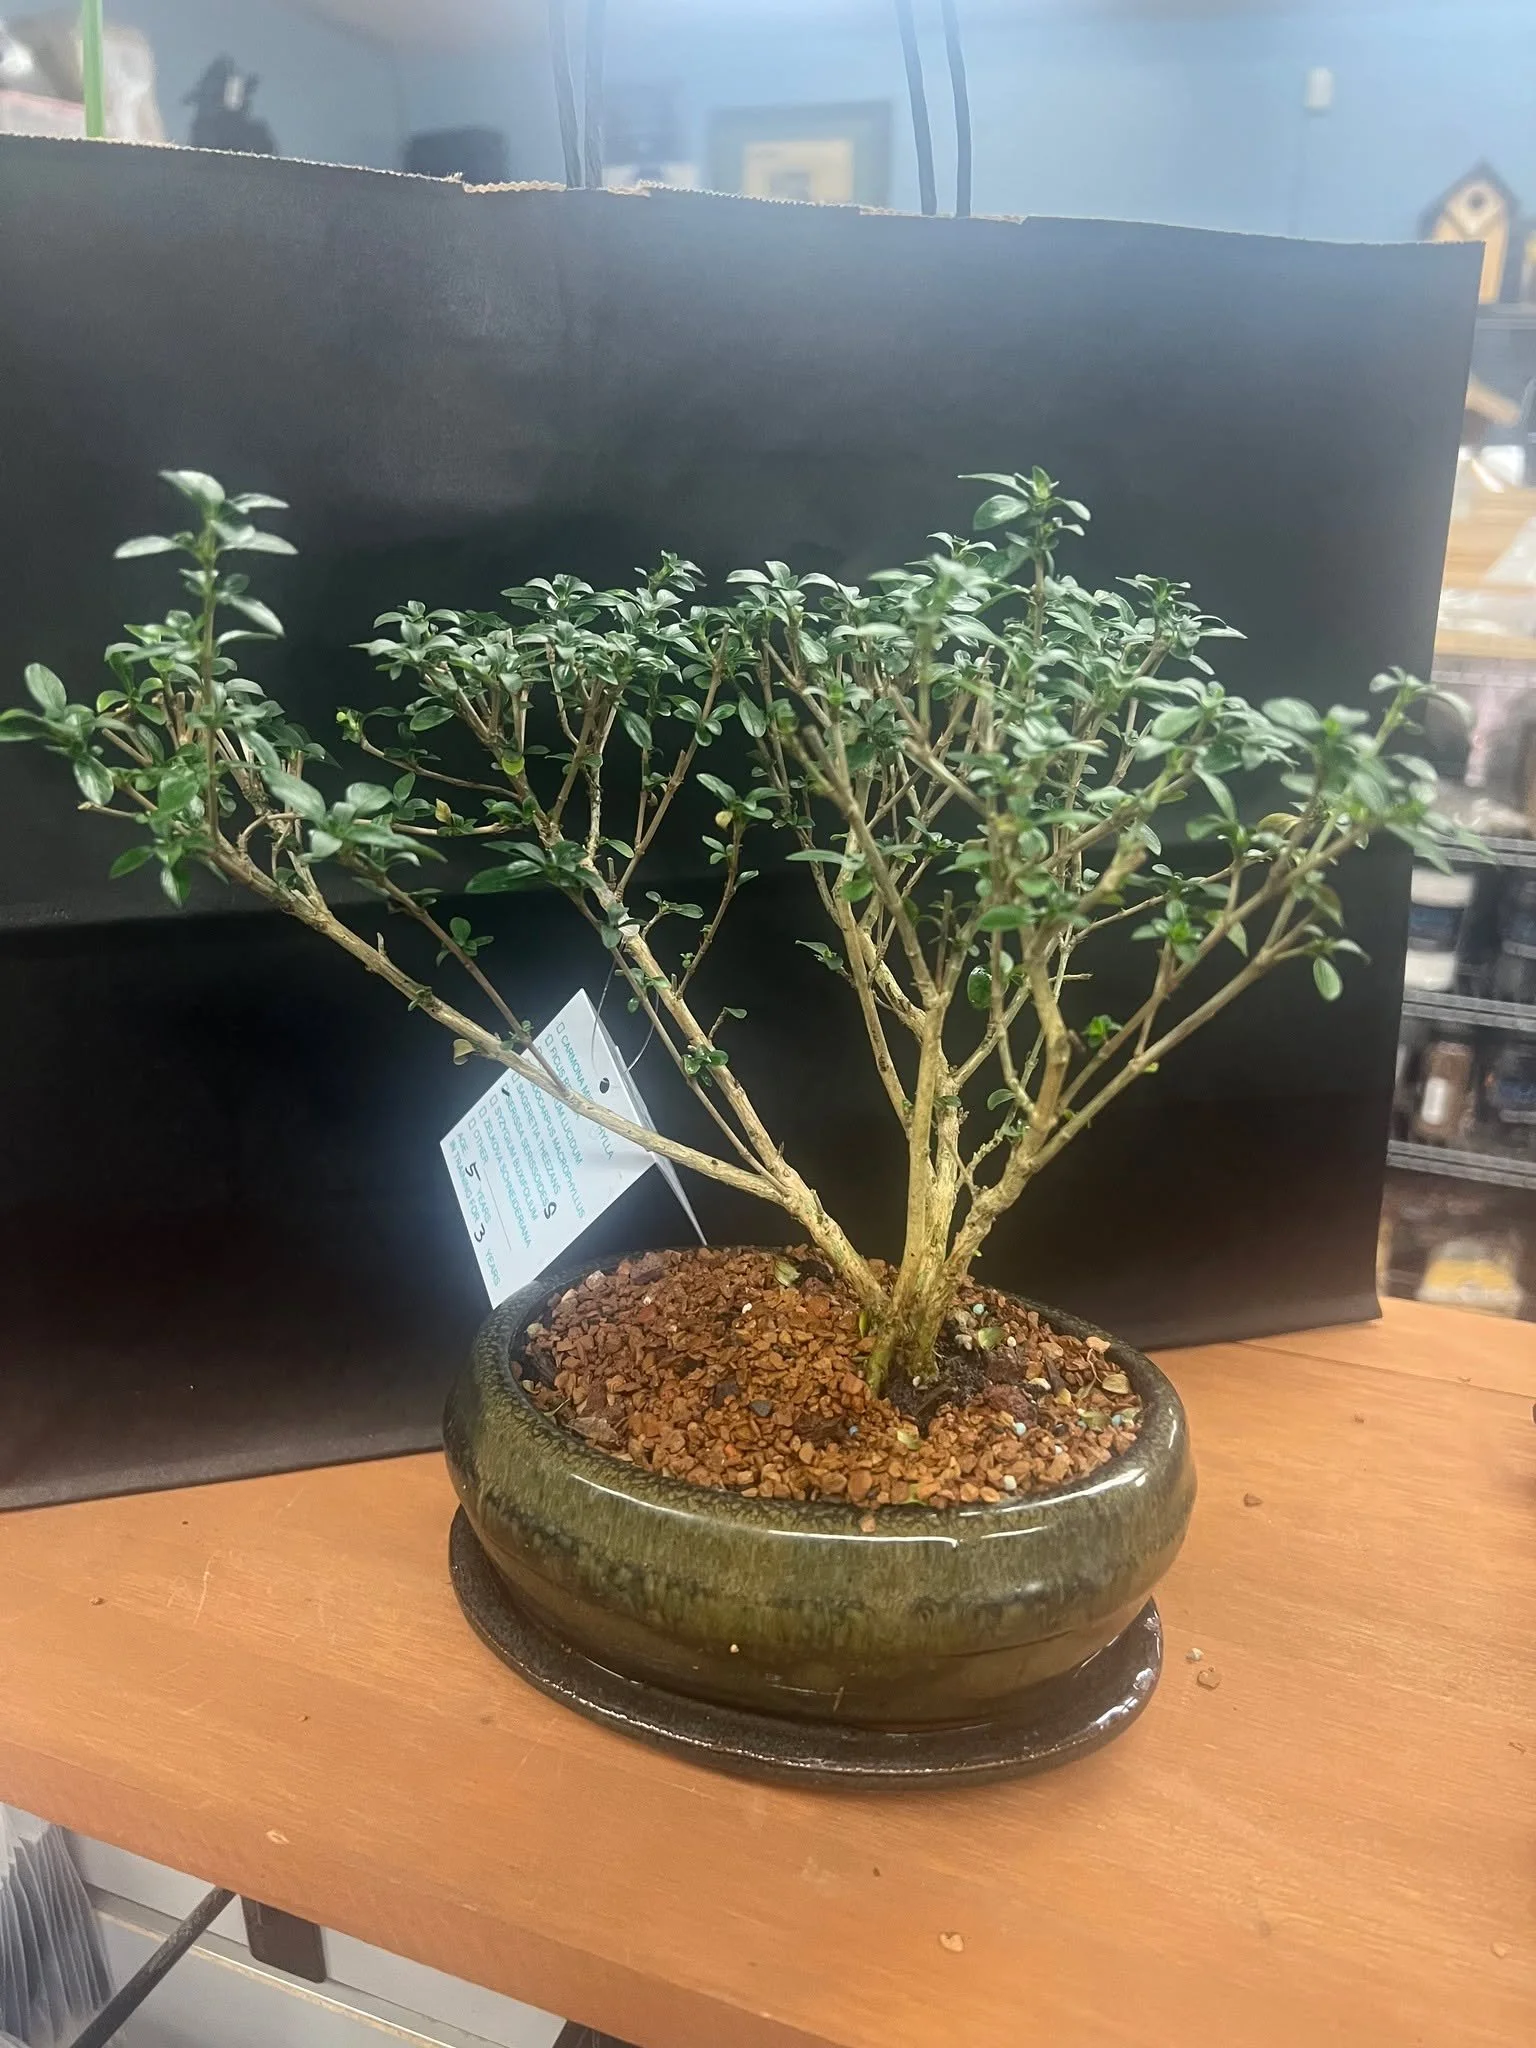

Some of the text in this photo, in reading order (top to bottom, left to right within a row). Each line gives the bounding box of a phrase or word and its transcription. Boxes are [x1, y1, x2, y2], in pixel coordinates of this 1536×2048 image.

[549, 1045, 566, 1079] FICUS
[560, 1033, 585, 1087] CARMONA
[473, 1128, 488, 1165] OTHER
[494, 1105, 538, 1222] SYZYGIUM BUXIFOLIUM
[505, 1094, 524, 1139] SERISSA
[520, 1136, 549, 1207] SERISSOIDES
[515, 1082, 540, 1141] SAGERETIA
[536, 1139, 561, 1195] THEEZANS
[550, 1136, 586, 1218] MACROPHYLLUS
[560, 1116, 583, 1165] LUCIDUM
[453, 1151, 472, 1200] TRAINING
[468, 1198, 479, 1223] FOR
[474, 1222, 486, 1243] 3
[484, 1248, 500, 1287] YEARS
[465, 1161, 481, 1182] 5
[476, 1187, 491, 1224] YEARS
[483, 1116, 532, 1248] ZELKOVA SCHNEIDERIANA
